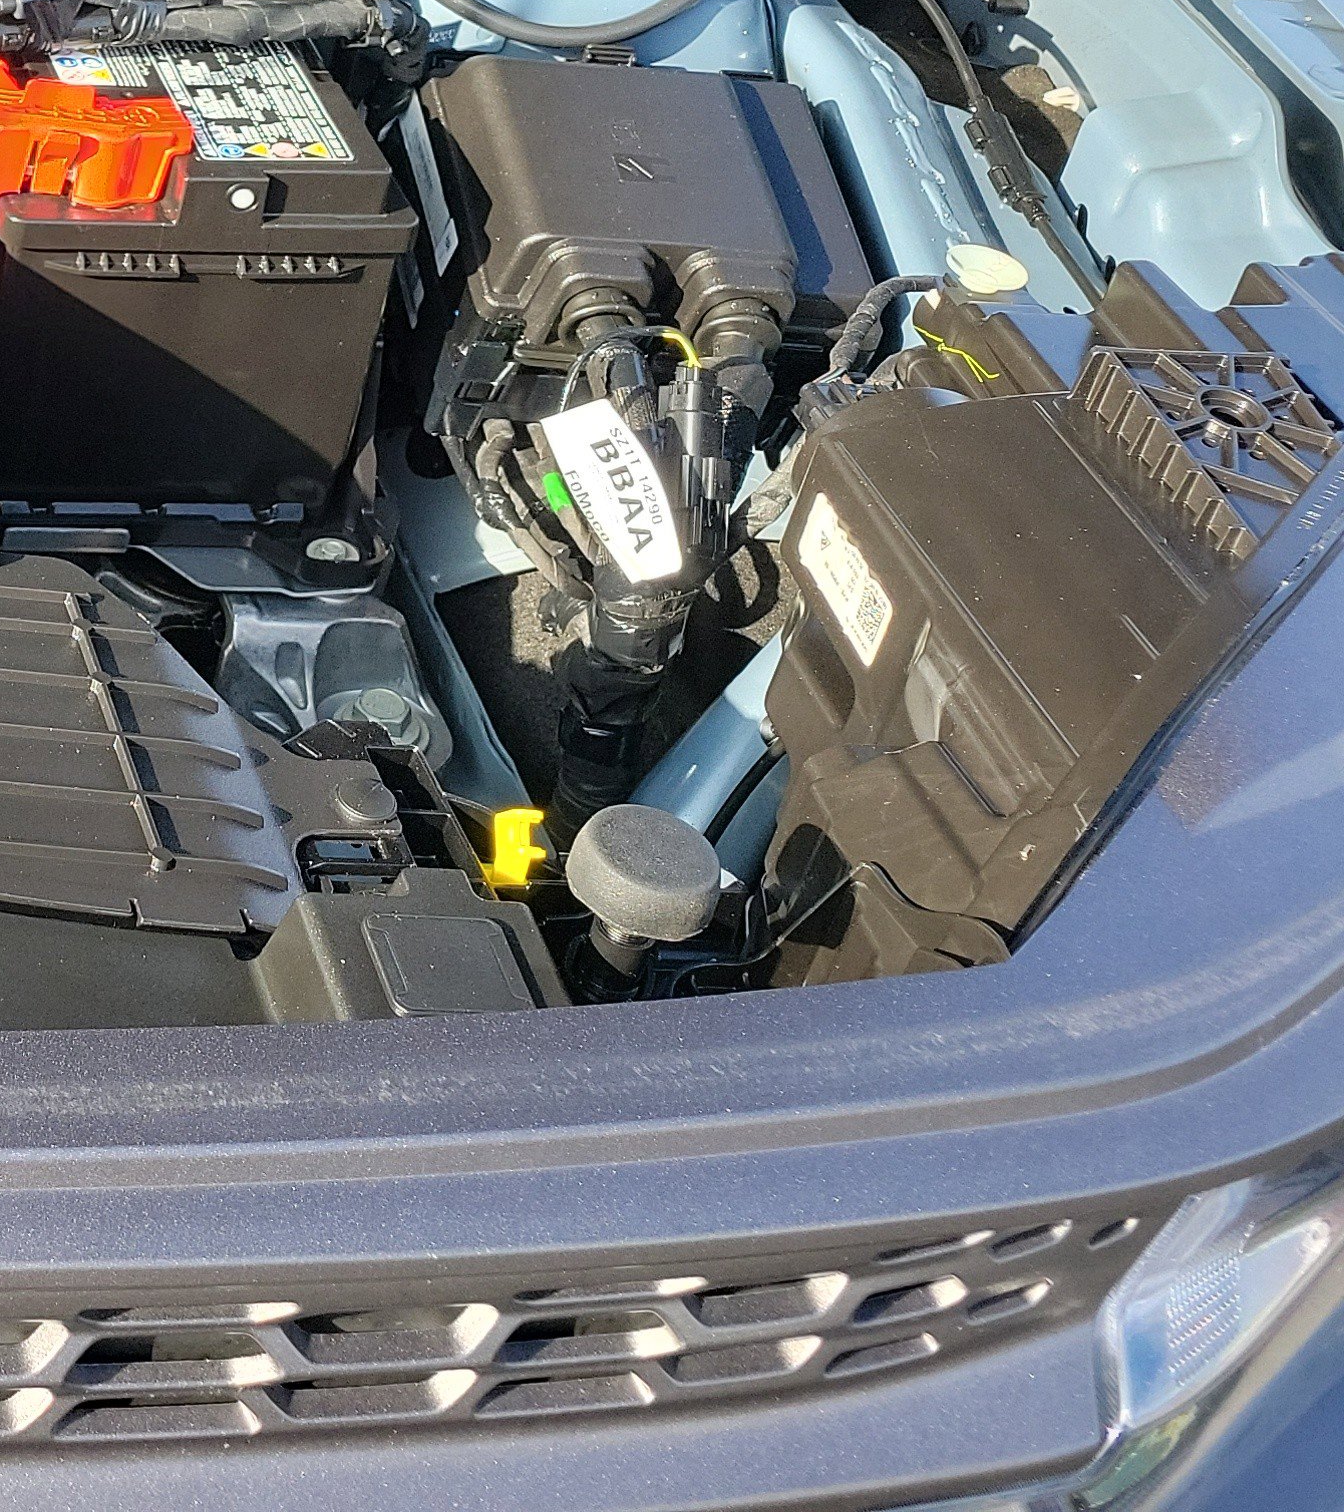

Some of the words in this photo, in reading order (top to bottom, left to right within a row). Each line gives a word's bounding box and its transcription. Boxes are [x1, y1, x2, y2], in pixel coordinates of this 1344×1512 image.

[589, 438, 654, 555] BBAA
[609, 427, 642, 466] SZ1T
[638, 475, 663, 525] 14290
